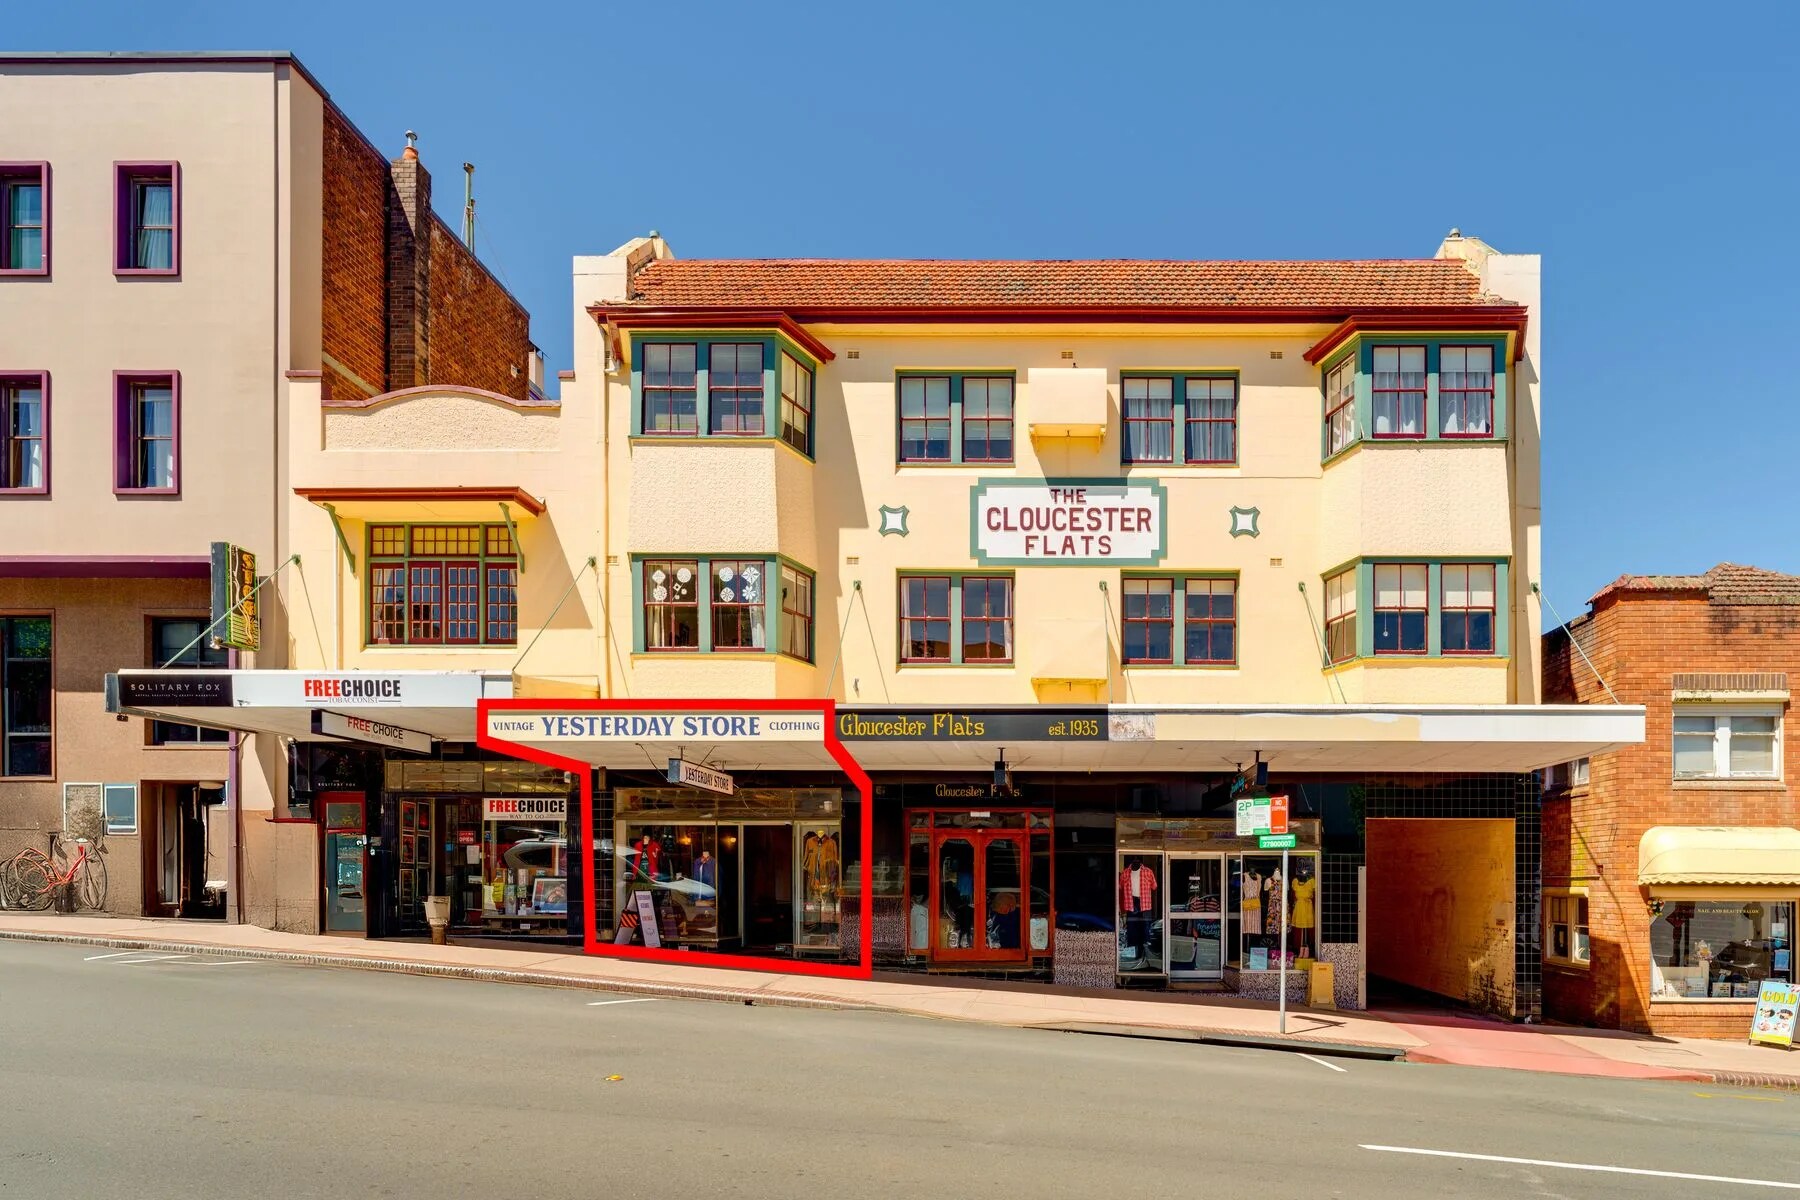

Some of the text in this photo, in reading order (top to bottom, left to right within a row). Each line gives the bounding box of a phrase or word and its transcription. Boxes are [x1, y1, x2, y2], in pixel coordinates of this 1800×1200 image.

[1051, 489, 1087, 503] THE
[1025, 536, 1111, 555] FLATS
[347, 717, 371, 733] FREE
[372, 723, 404, 740] CHOICE
[493, 716, 820, 736] VINTAGE YESTERDAY STORE CLOTHING
[840, 713, 926, 736] Gloucester
[933, 712, 985, 736] Flats
[685, 766, 729, 790] YESTERDAY STORE
[935, 783, 985, 797] Gloucester
[1238, 802, 1252, 812] 2P
[1762, 991, 1797, 1004] GOLD
